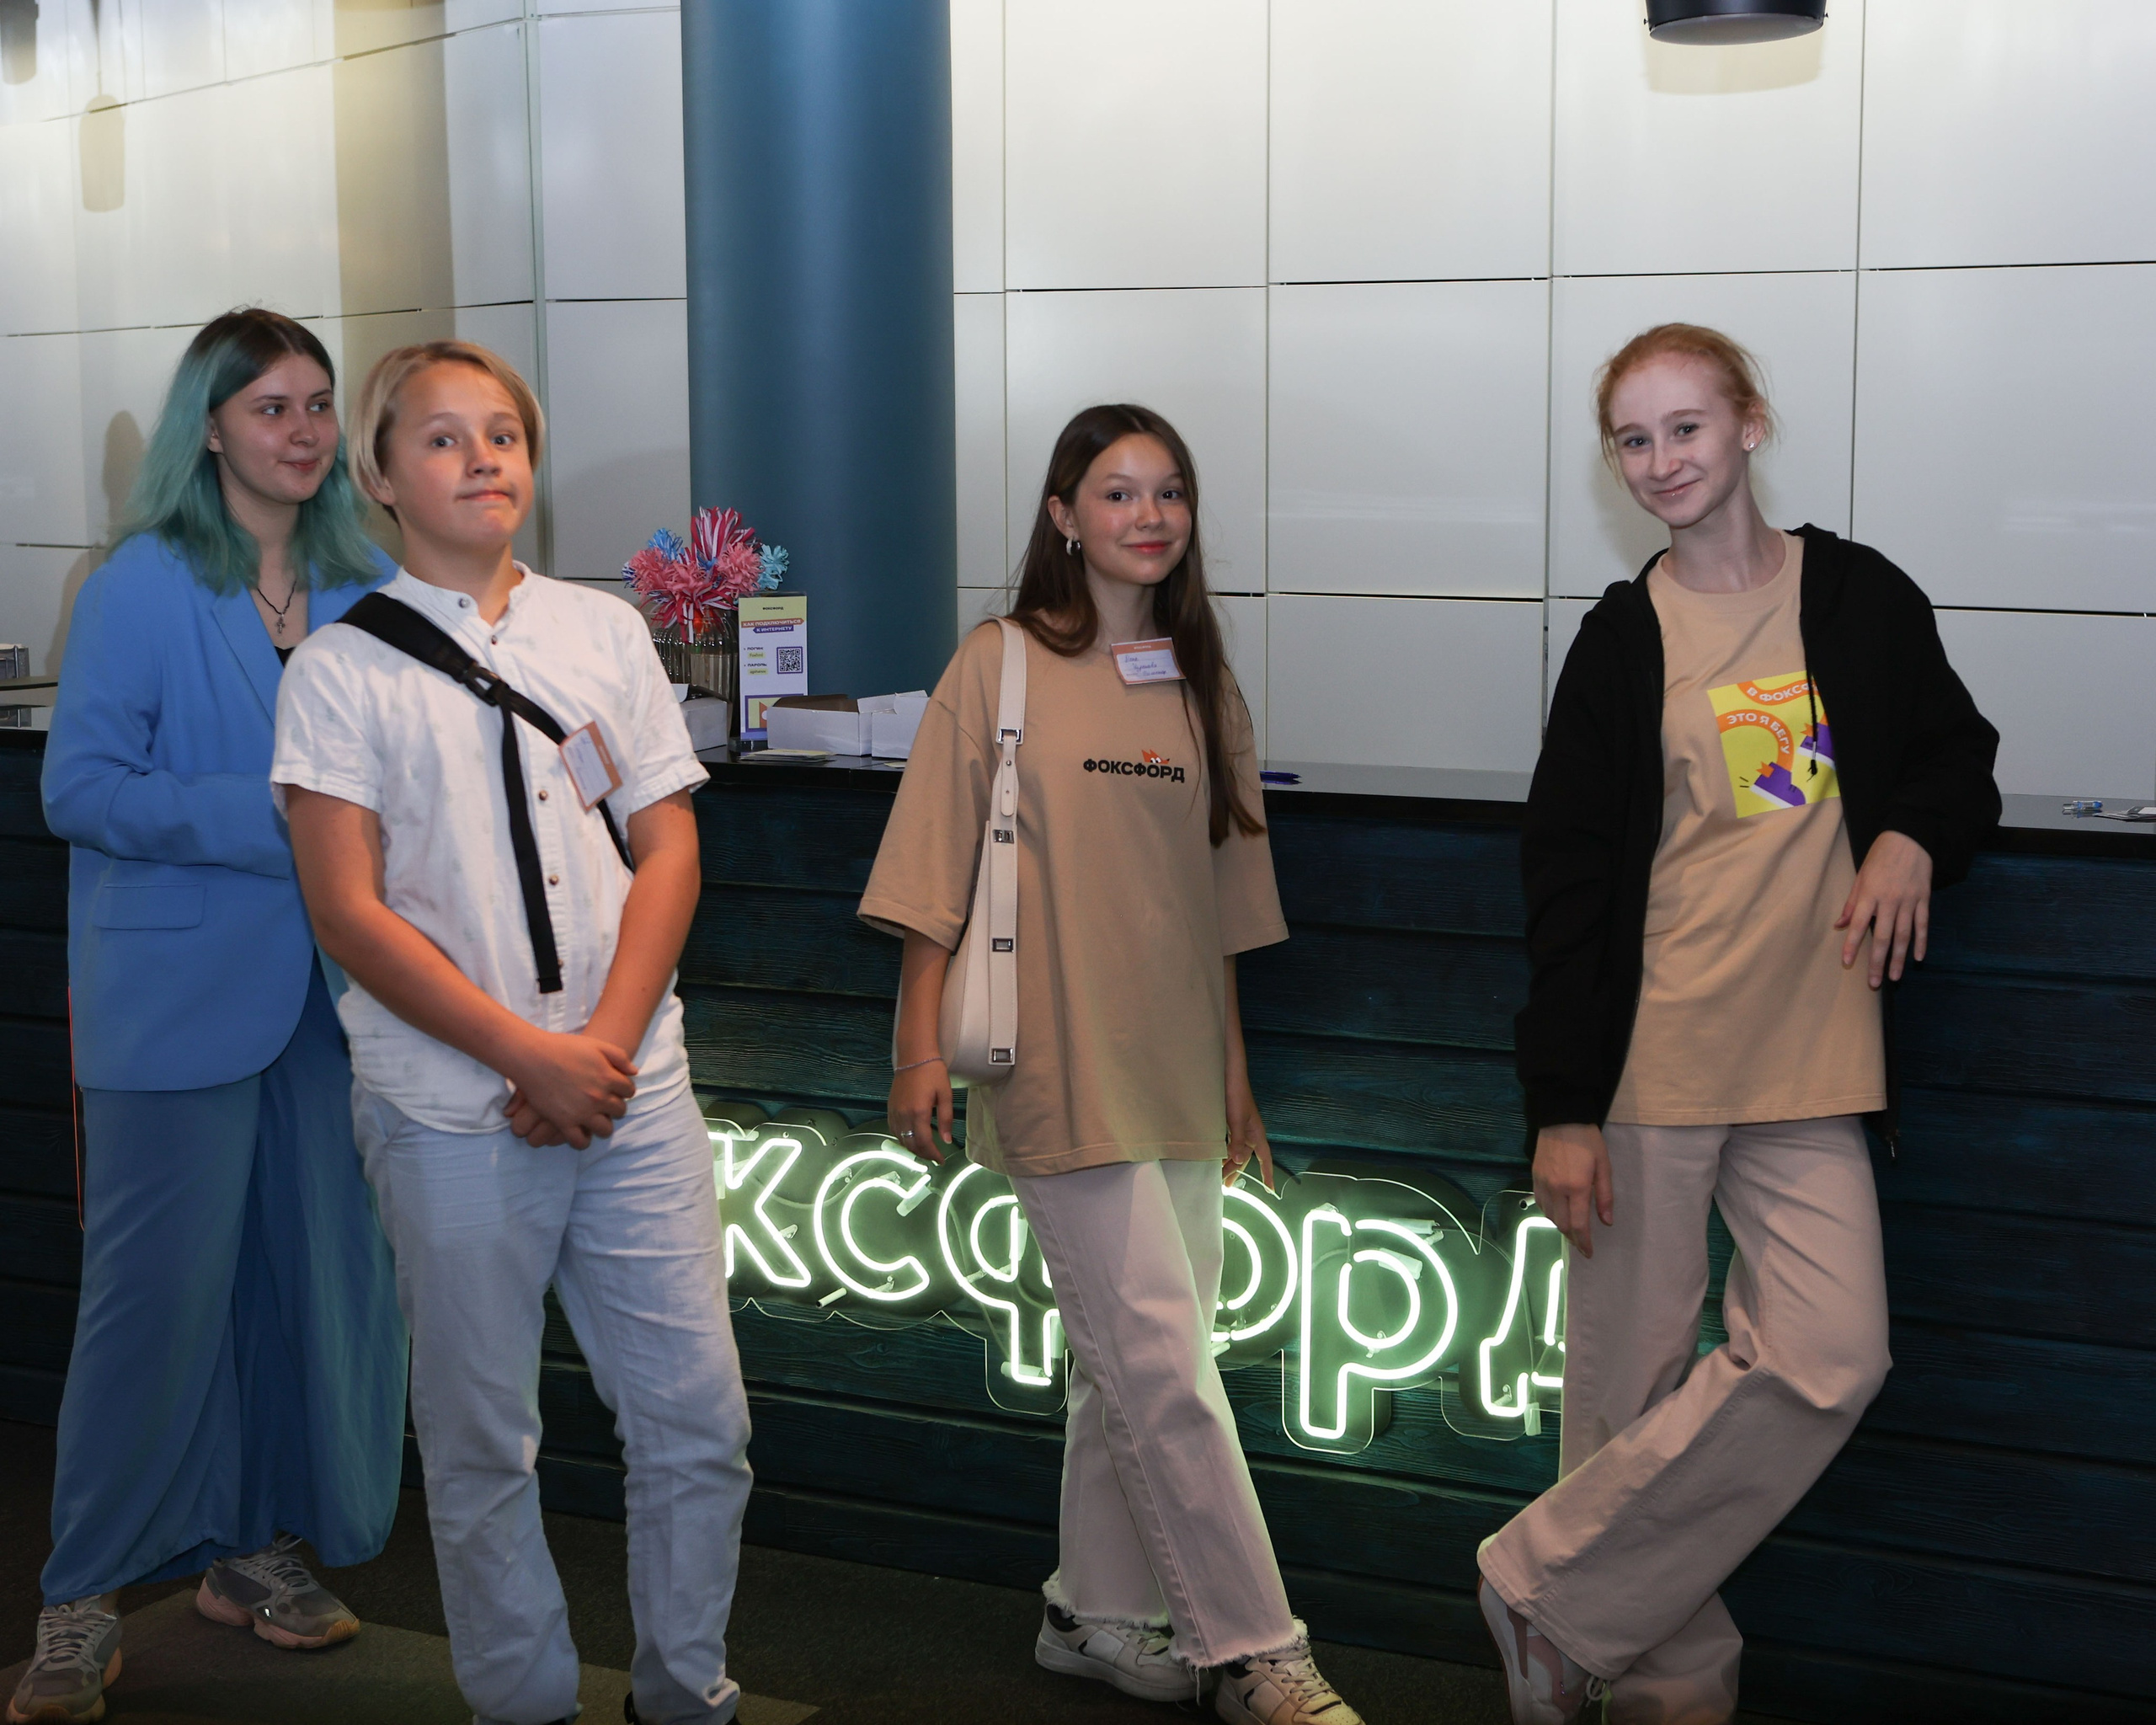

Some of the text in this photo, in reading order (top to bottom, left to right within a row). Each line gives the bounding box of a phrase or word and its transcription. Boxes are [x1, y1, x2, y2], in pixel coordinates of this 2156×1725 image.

[1747, 683, 1818, 702] В ФОКСФ
[1726, 713, 1791, 755] ЭТО Я БЕГУ
[1083, 759, 1185, 783] ФОКСФОРД
